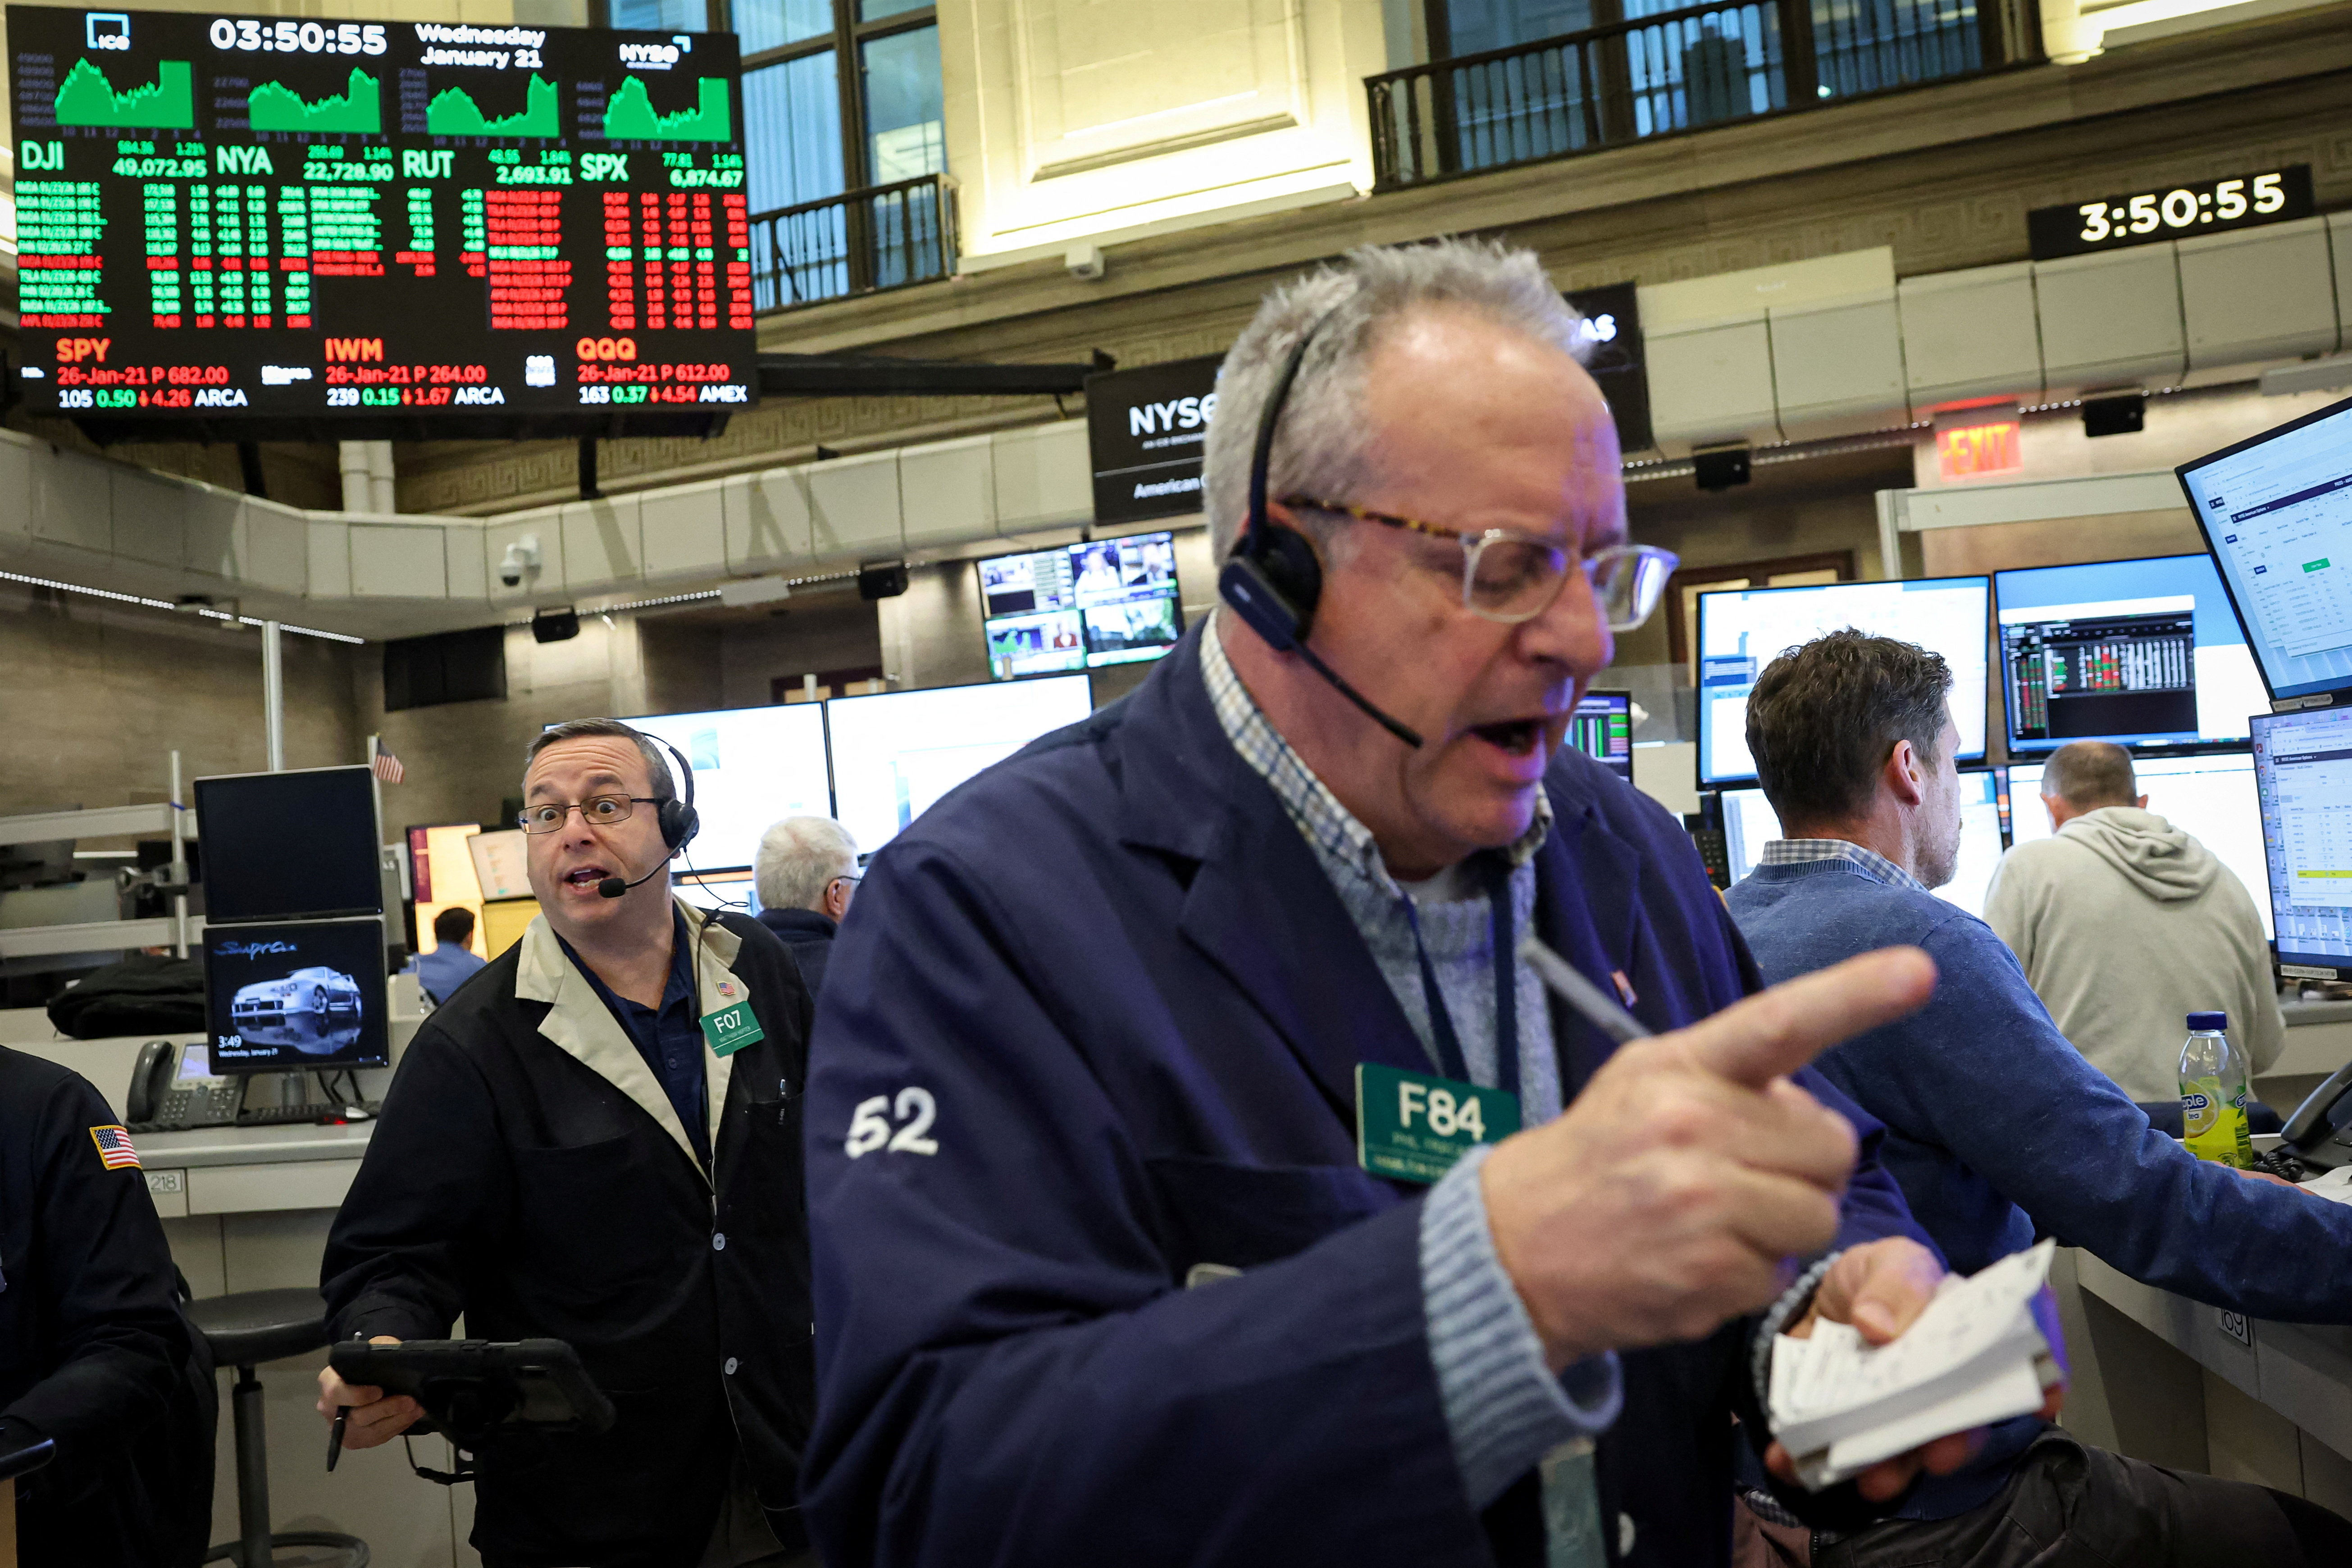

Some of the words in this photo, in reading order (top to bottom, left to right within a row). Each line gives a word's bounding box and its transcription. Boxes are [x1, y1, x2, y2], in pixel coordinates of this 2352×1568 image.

[210, 18, 387, 55] 03:50:55
[415, 23, 546, 49] Wednesday
[420, 46, 510, 69] January
[515, 49, 543, 68] 21
[21, 140, 64, 170] DJI
[216, 145, 273, 175] NYA
[402, 149, 455, 178] RUT
[580, 153, 629, 181] SPX
[112, 158, 208, 178] 49,072.95
[303, 161, 394, 182] 22,728.90
[497, 165, 573, 185] 2,693.91
[670, 169, 743, 188] 6,874.67
[2079, 173, 2285, 242] 3:50:55
[56, 338, 111, 362] SPY
[325, 338, 383, 362] IWM
[576, 337, 637, 361] QQQ
[57, 366, 148, 385] 26-Jan-21
[151, 367, 165, 384] P
[168, 366, 229, 385] 682.00
[326, 365, 411, 383] 26-Jan-21
[414, 365, 426, 383] P
[429, 365, 487, 383] 264.00
[578, 365, 659, 382] 26-Jan-21
[661, 365, 674, 381] P
[676, 364, 730, 382] 612.00
[59, 389, 93, 407] 105
[96, 389, 136, 408] 0.50
[152, 389, 191, 407] 4.26
[195, 388, 248, 406] ARCA
[327, 388, 360, 406] 239
[362, 388, 400, 406] 0.15
[415, 387, 451, 405] 1.67
[454, 387, 505, 405] ARCA
[579, 386, 610, 404] 163
[612, 386, 648, 403] 0.37
[661, 386, 697, 403] 4.54
[699, 385, 747, 403] AMEX
[1948, 424, 2011, 475] EXIT
[713, 1009, 741, 1033] F07
[218, 1035, 242, 1048] 3:49
[844, 1086, 939, 1159] 52
[1399, 1080, 1486, 1142] F84
[150, 1175, 176, 1190] 218
